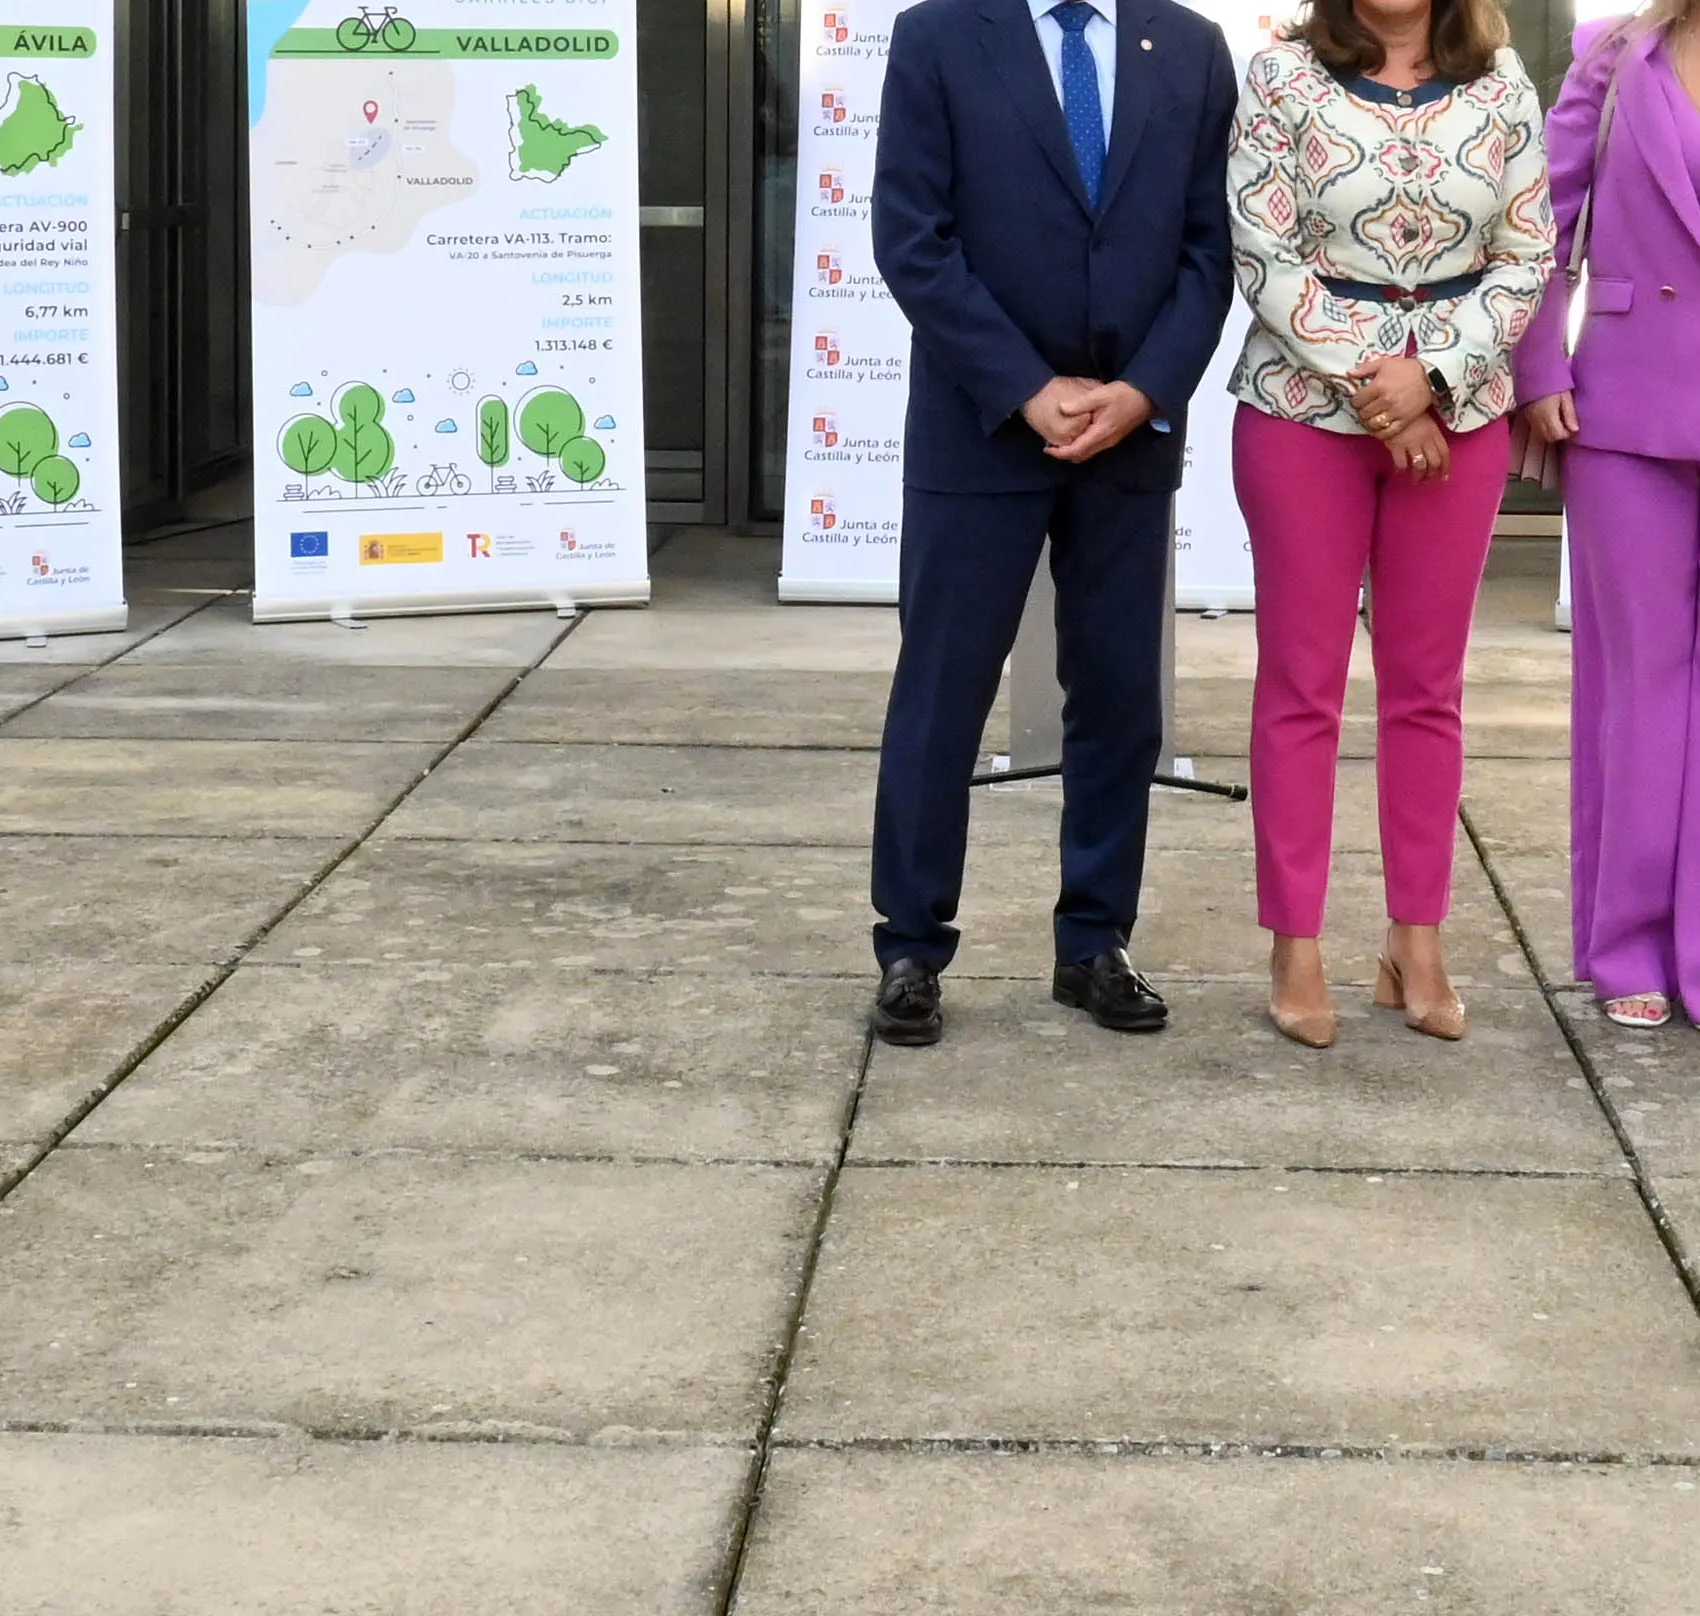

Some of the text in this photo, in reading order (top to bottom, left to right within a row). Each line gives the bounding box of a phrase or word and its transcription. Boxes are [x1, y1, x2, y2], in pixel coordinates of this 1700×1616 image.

[13, 29, 88, 52] ÁVILA
[456, 35, 610, 53] VALLADOLID
[406, 176, 474, 186] VALLADOLID
[29, 220, 88, 233] AV-900
[60, 238, 88, 252] vial
[426, 232, 612, 246] Carretera VA-113. Tramo:
[19, 258, 38, 267] del
[39, 258, 60, 269] Rey
[562, 293, 613, 307] 2,5 km
[24, 305, 89, 319] 6,77 km
[534, 338, 613, 352] 1.313.148 €
[0, 352, 88, 366] 1.444.681 €
[844, 355, 902, 368] Junta de
[806, 367, 902, 383] Castilla y León
